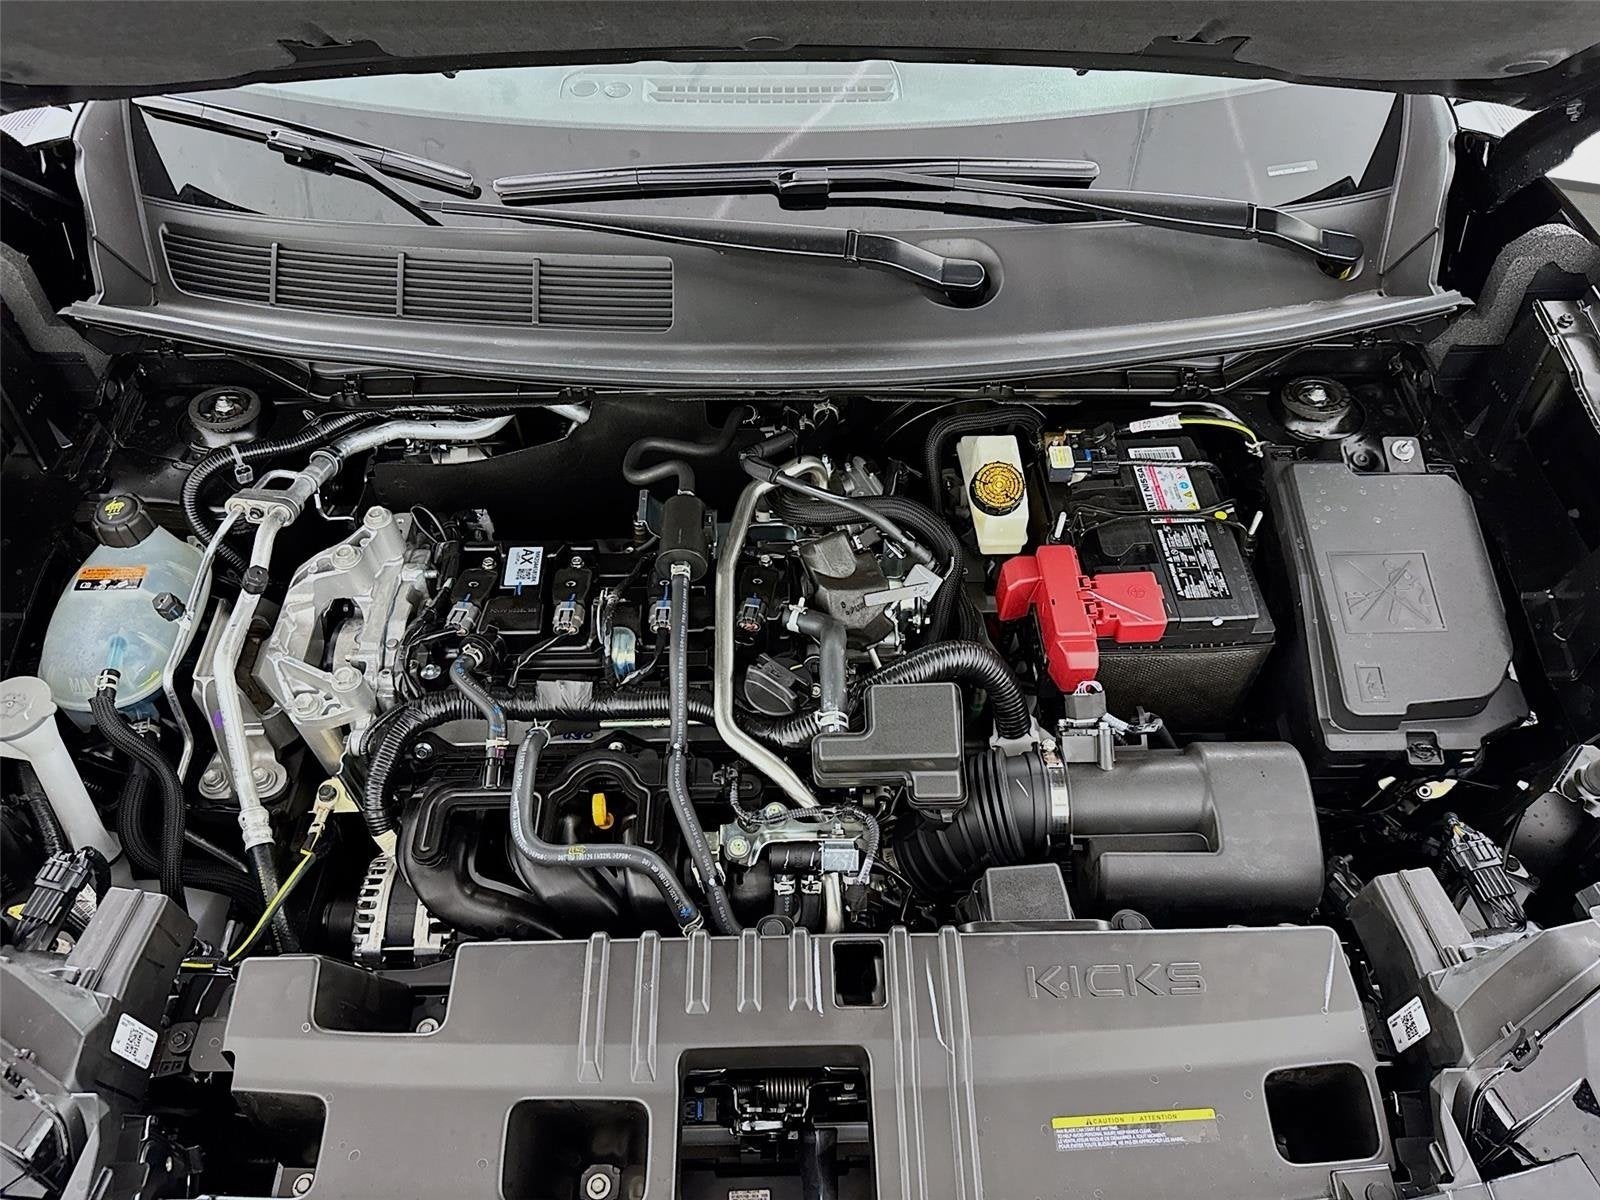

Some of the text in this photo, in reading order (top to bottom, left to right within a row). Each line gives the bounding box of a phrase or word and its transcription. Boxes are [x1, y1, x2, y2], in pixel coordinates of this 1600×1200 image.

[1137, 466, 1150, 492] NISSA
[520, 549, 534, 565] AX
[1026, 962, 1207, 999] KICKS
